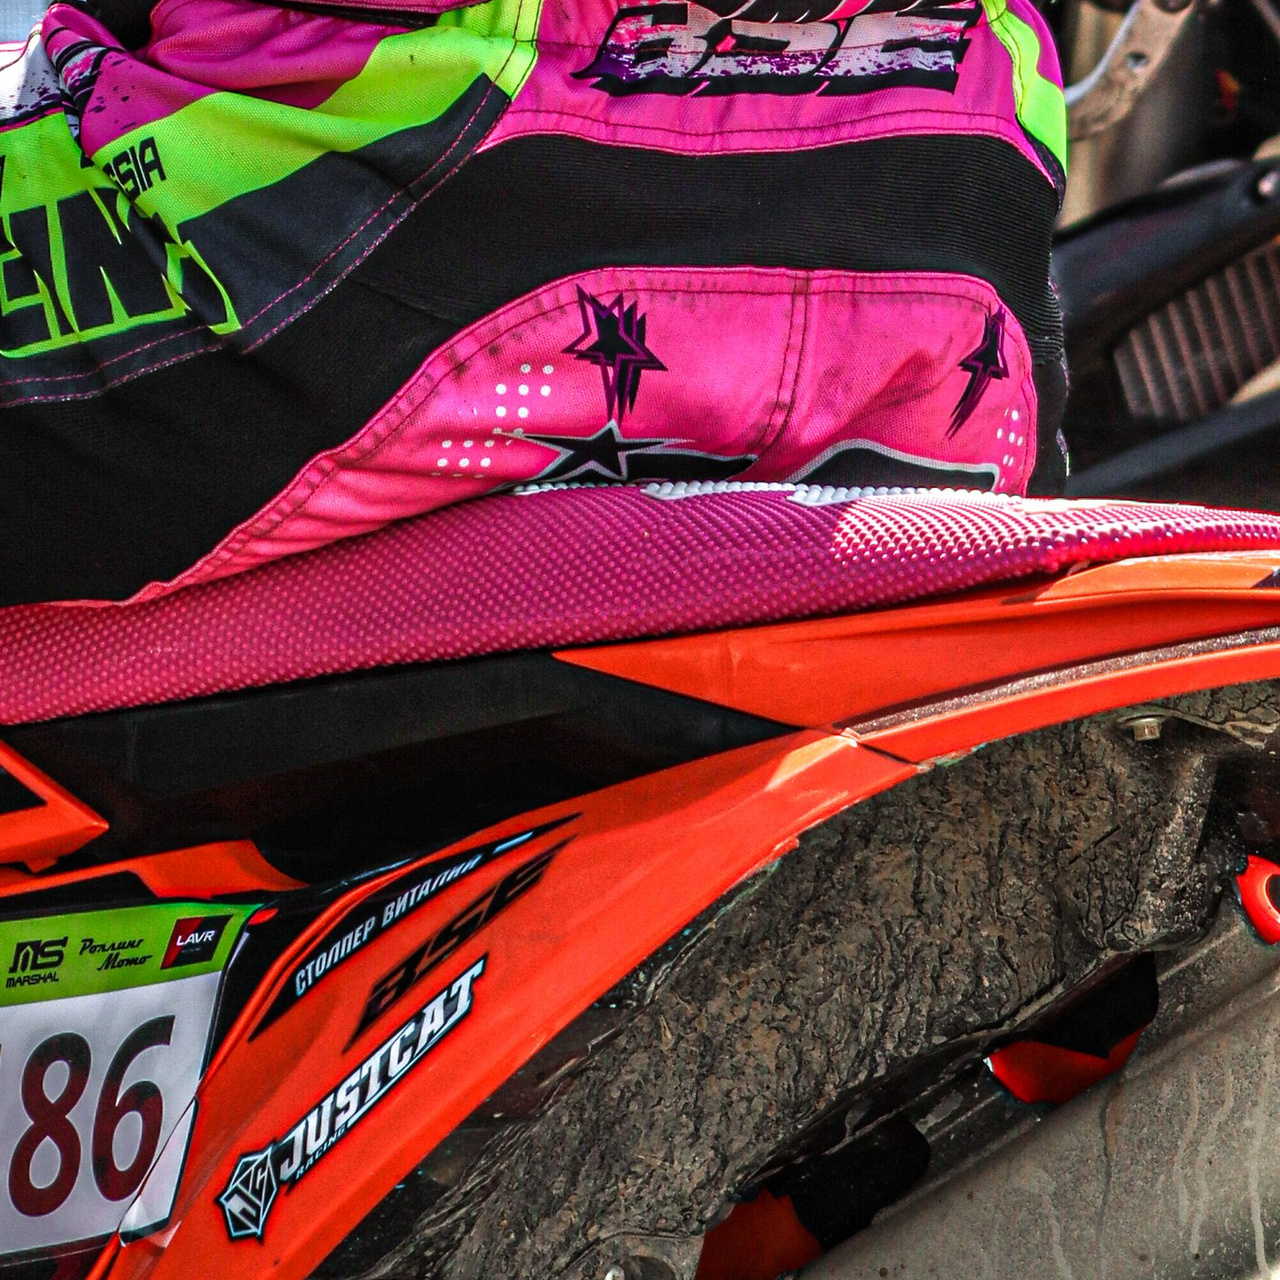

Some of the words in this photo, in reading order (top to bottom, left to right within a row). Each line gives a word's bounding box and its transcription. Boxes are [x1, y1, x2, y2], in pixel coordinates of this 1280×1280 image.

[175, 930, 216, 948] LAVR
[5, 972, 60, 989] MARSHAL
[280, 956, 486, 1181] JUSTCAT
[295, 1125, 347, 1180] RACING
